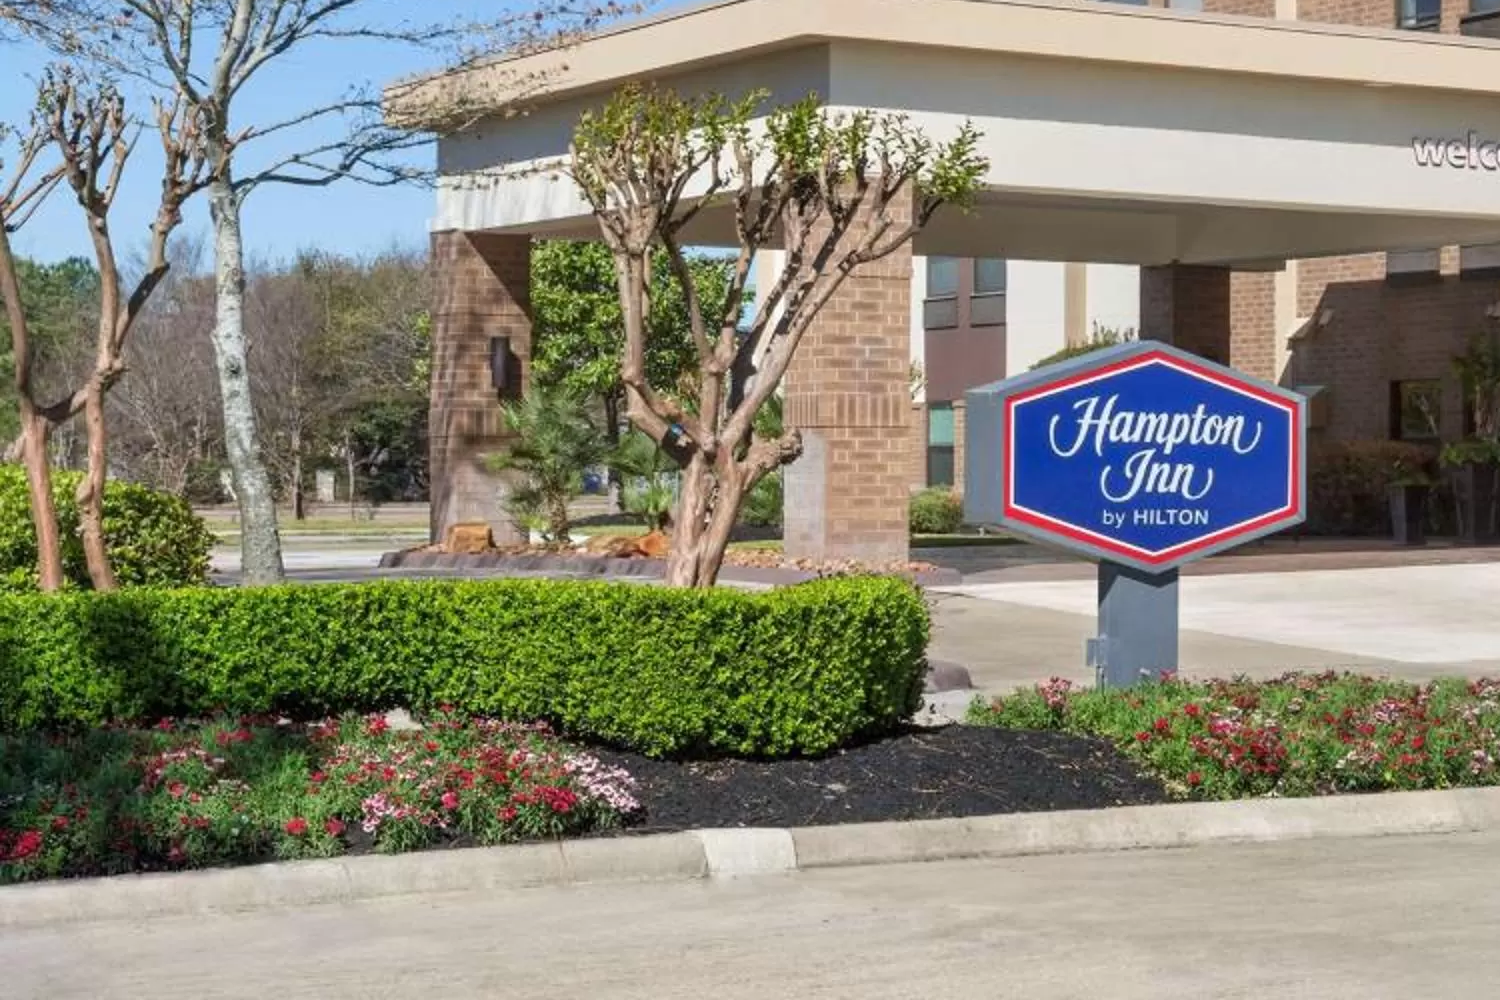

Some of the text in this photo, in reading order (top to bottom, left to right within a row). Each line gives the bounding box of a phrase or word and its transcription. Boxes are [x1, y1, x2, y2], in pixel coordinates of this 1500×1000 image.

[1049, 393, 1262, 457] Hampton
[1100, 449, 1214, 502] Inn
[1102, 509, 1209, 529] by HILTON
